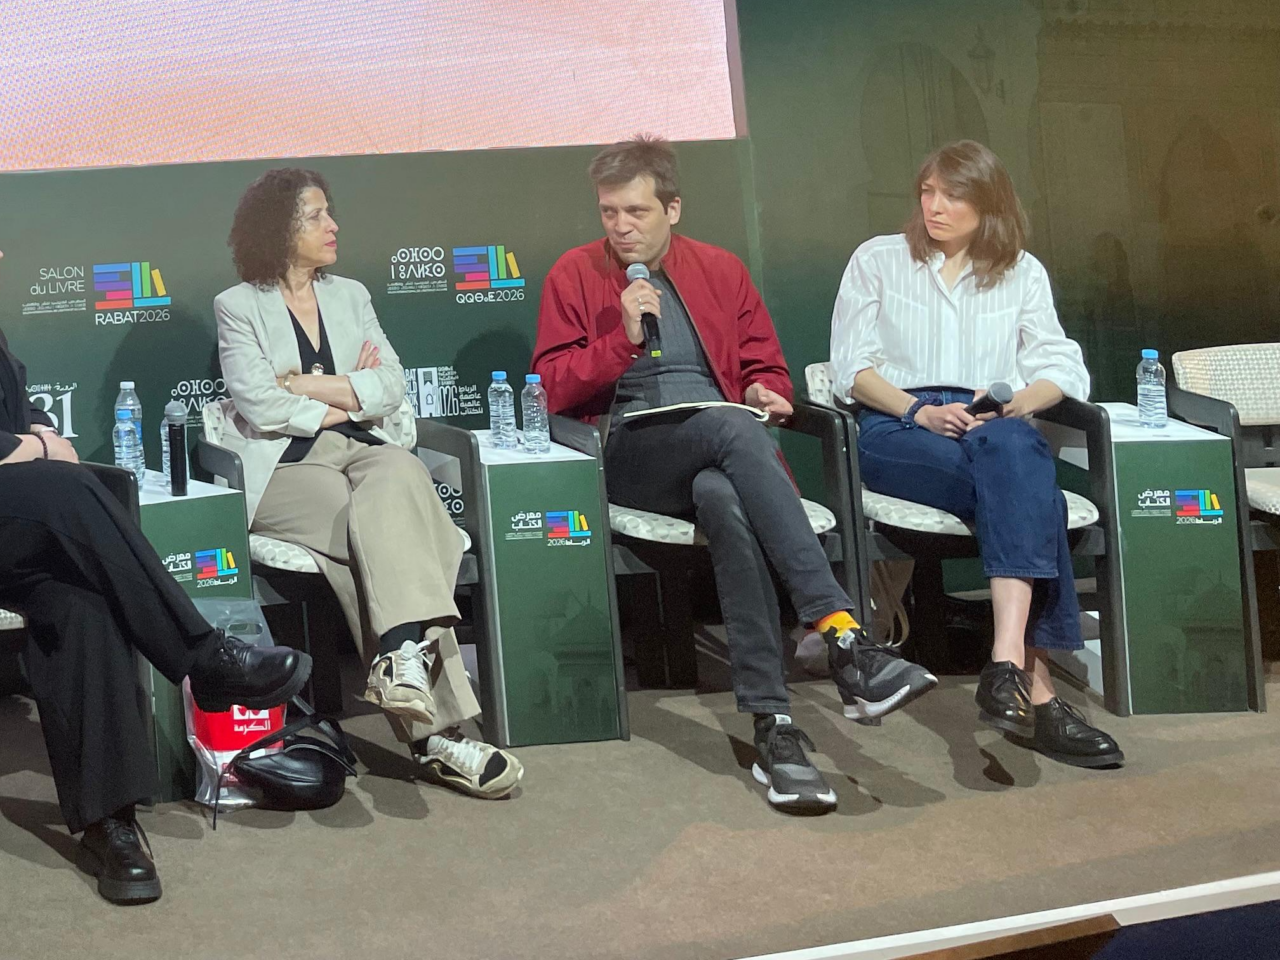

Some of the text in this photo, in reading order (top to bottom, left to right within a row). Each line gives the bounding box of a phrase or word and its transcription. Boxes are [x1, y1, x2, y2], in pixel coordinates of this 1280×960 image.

[40, 266, 84, 280] SALON
[30, 280, 85, 295] du LIVRE
[95, 309, 170, 325] RABAT2026
[404, 368, 417, 381] BAT
[233, 719, 271, 735] الكرمة
